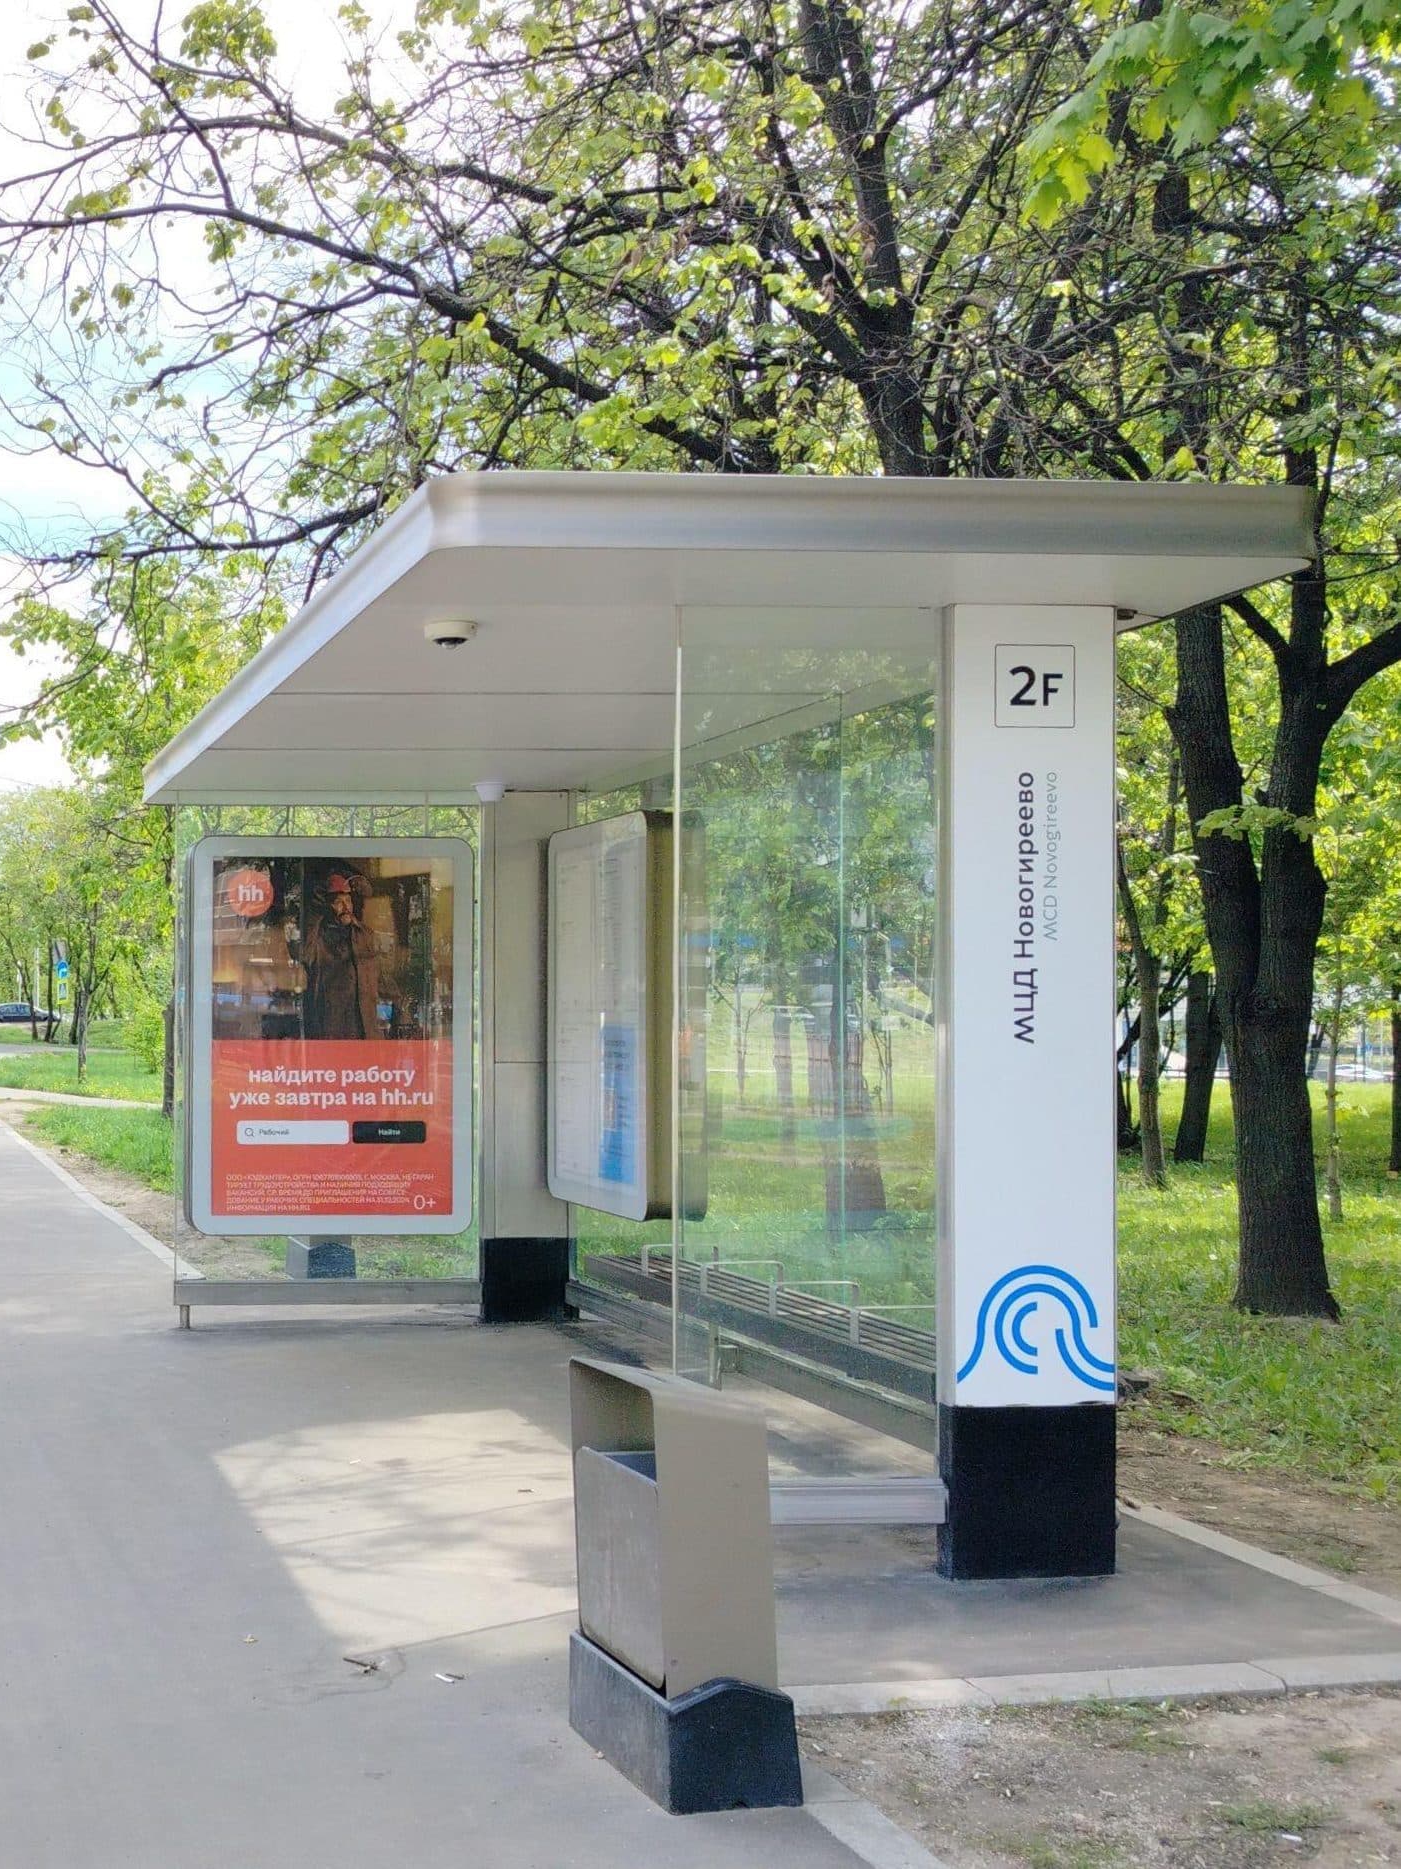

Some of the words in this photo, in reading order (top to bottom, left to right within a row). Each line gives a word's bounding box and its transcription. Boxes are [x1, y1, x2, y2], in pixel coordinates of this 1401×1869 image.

[1009, 665, 1064, 706] 2F
[1043, 772, 1061, 888] Novogireevo
[1013, 772, 1039, 958] Новогиреево
[238, 884, 264, 901] hh
[1043, 894, 1058, 942] MCD
[1013, 968, 1039, 1045] МЦД
[248, 1066, 337, 1084] найдите
[341, 1066, 416, 1086] работу
[229, 1091, 270, 1109] уже
[274, 1091, 347, 1109] завтра
[352, 1091, 377, 1105] на
[381, 1088, 434, 1105] hh.ru
[378, 1128, 401, 1136] Найти
[413, 1195, 436, 1210] 0+
